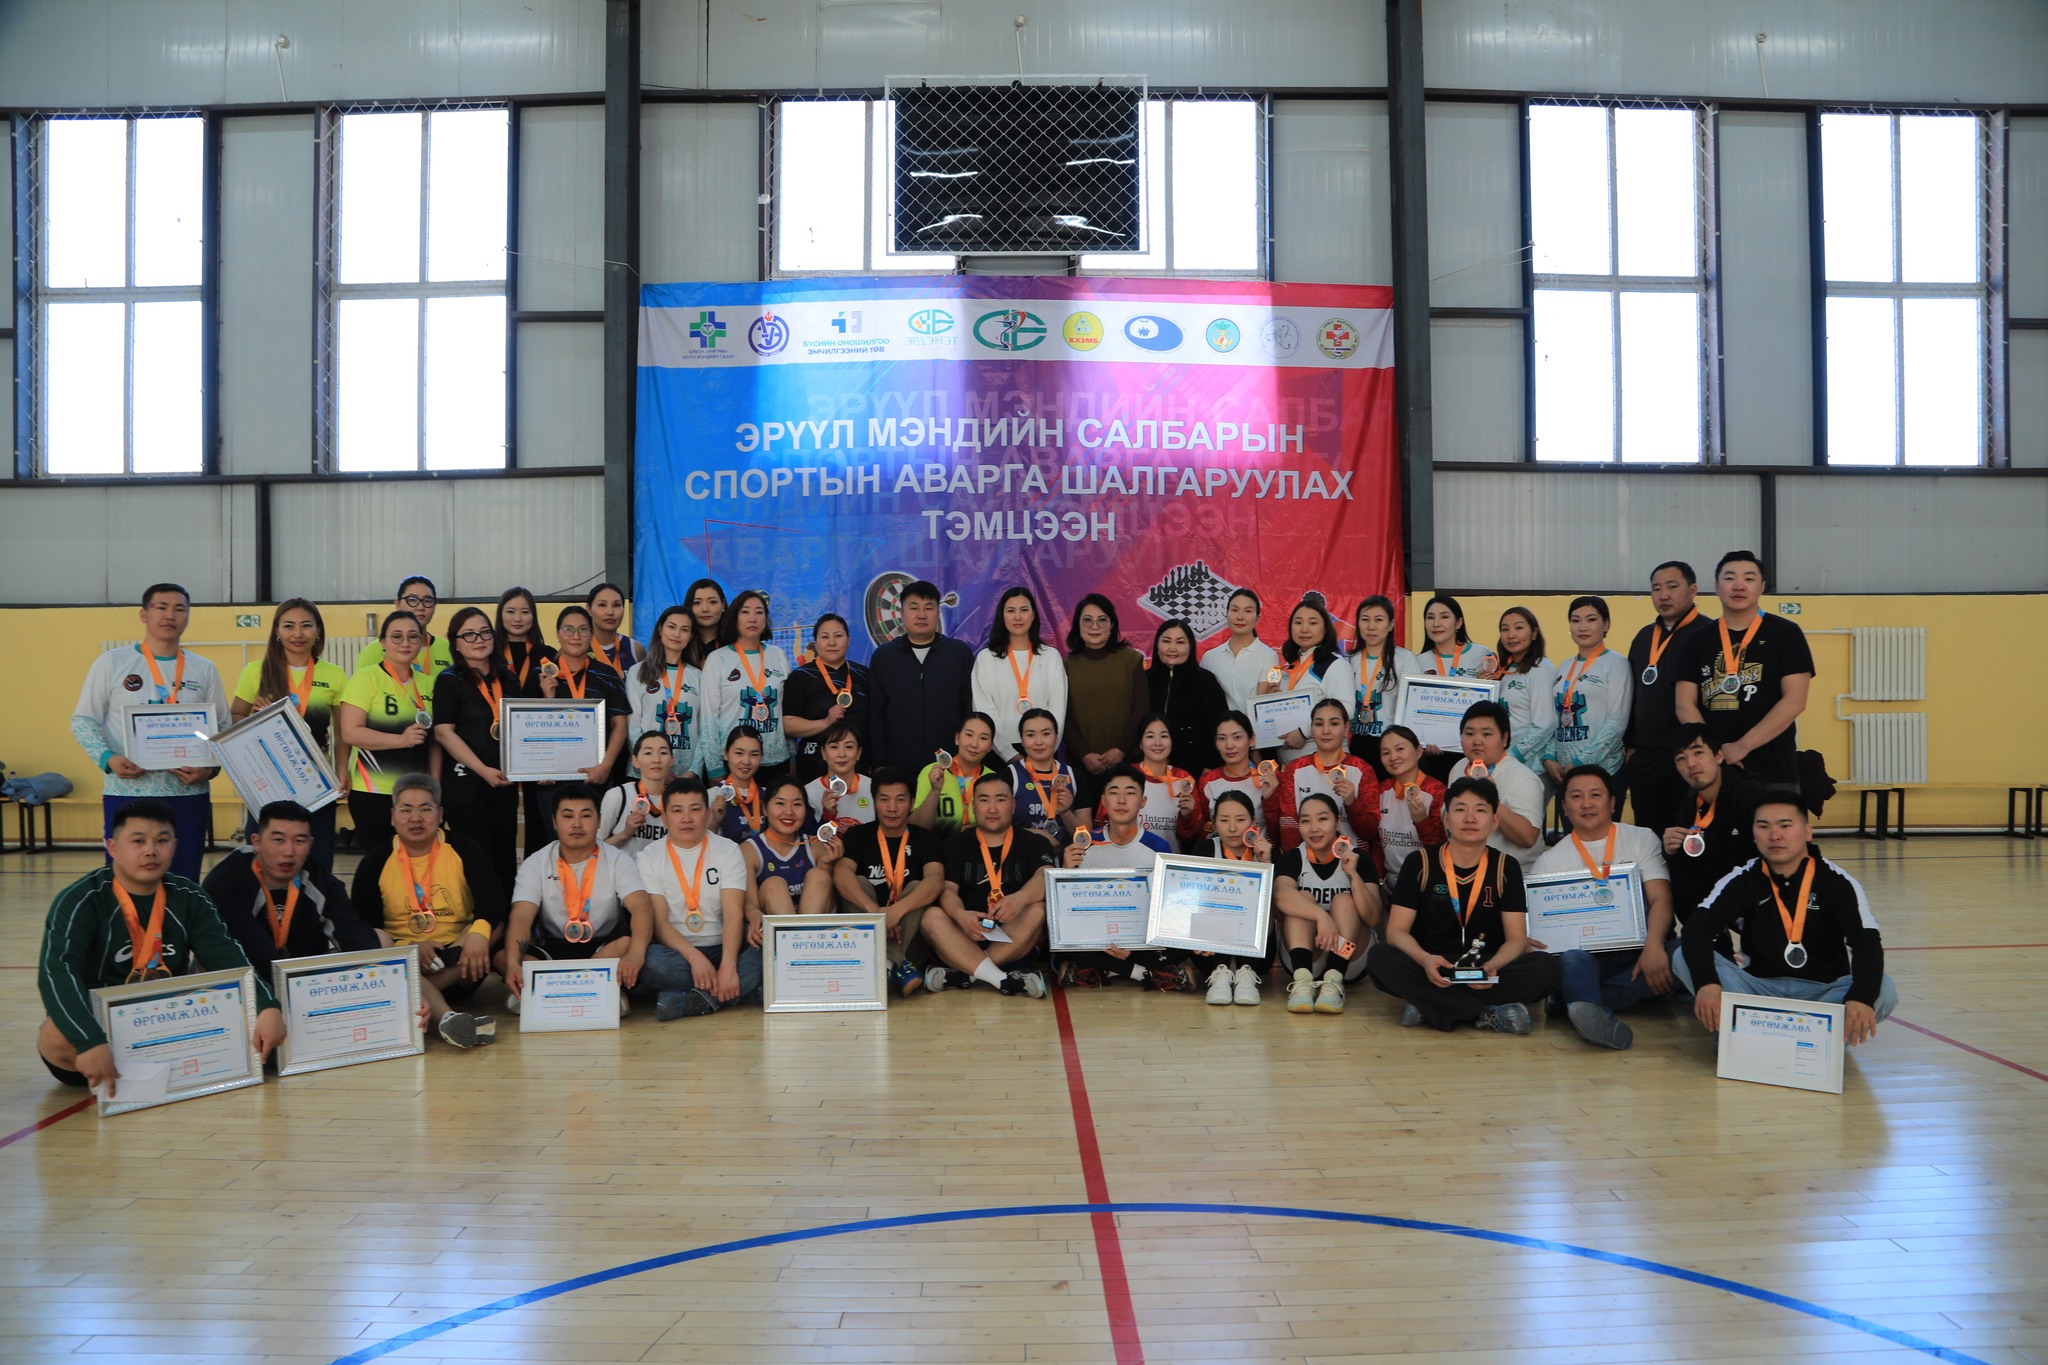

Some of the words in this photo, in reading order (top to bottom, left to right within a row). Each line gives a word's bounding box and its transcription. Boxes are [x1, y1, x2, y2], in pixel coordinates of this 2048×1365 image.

[837, 338, 890, 346] ОНОШИЛГОО
[905, 336, 958, 346] ЭРДЭНЭТ
[735, 418, 854, 452] ЭРҮҮЛ
[868, 409, 1064, 453] МЭНДИЙН
[1077, 418, 1304, 453] САЛБАРЫН
[685, 465, 880, 500] СПОРТЫН
[894, 463, 1049, 494] АВАРГА
[1061, 463, 1354, 501] ШАЛГАРУУЛАХ
[921, 509, 1116, 545] ТЭМЦЭЭН
[1743, 685, 1758, 702] P
[385, 695, 398, 715] 6
[1145, 814, 1178, 823] Internal
[1384, 829, 1413, 839] Internal
[706, 868, 719, 885] C
[1483, 886, 1493, 907] 1
[792, 941, 857, 950] ӨРГӨМЖЛӨЛ
[309, 979, 386, 997] ӨРГӨМЖЛӨЛ
[133, 1005, 219, 1028] ӨРГӨМЖЛӨЛ
[1750, 1019, 1811, 1033] ӨРГӨМЖЛӨЛ
